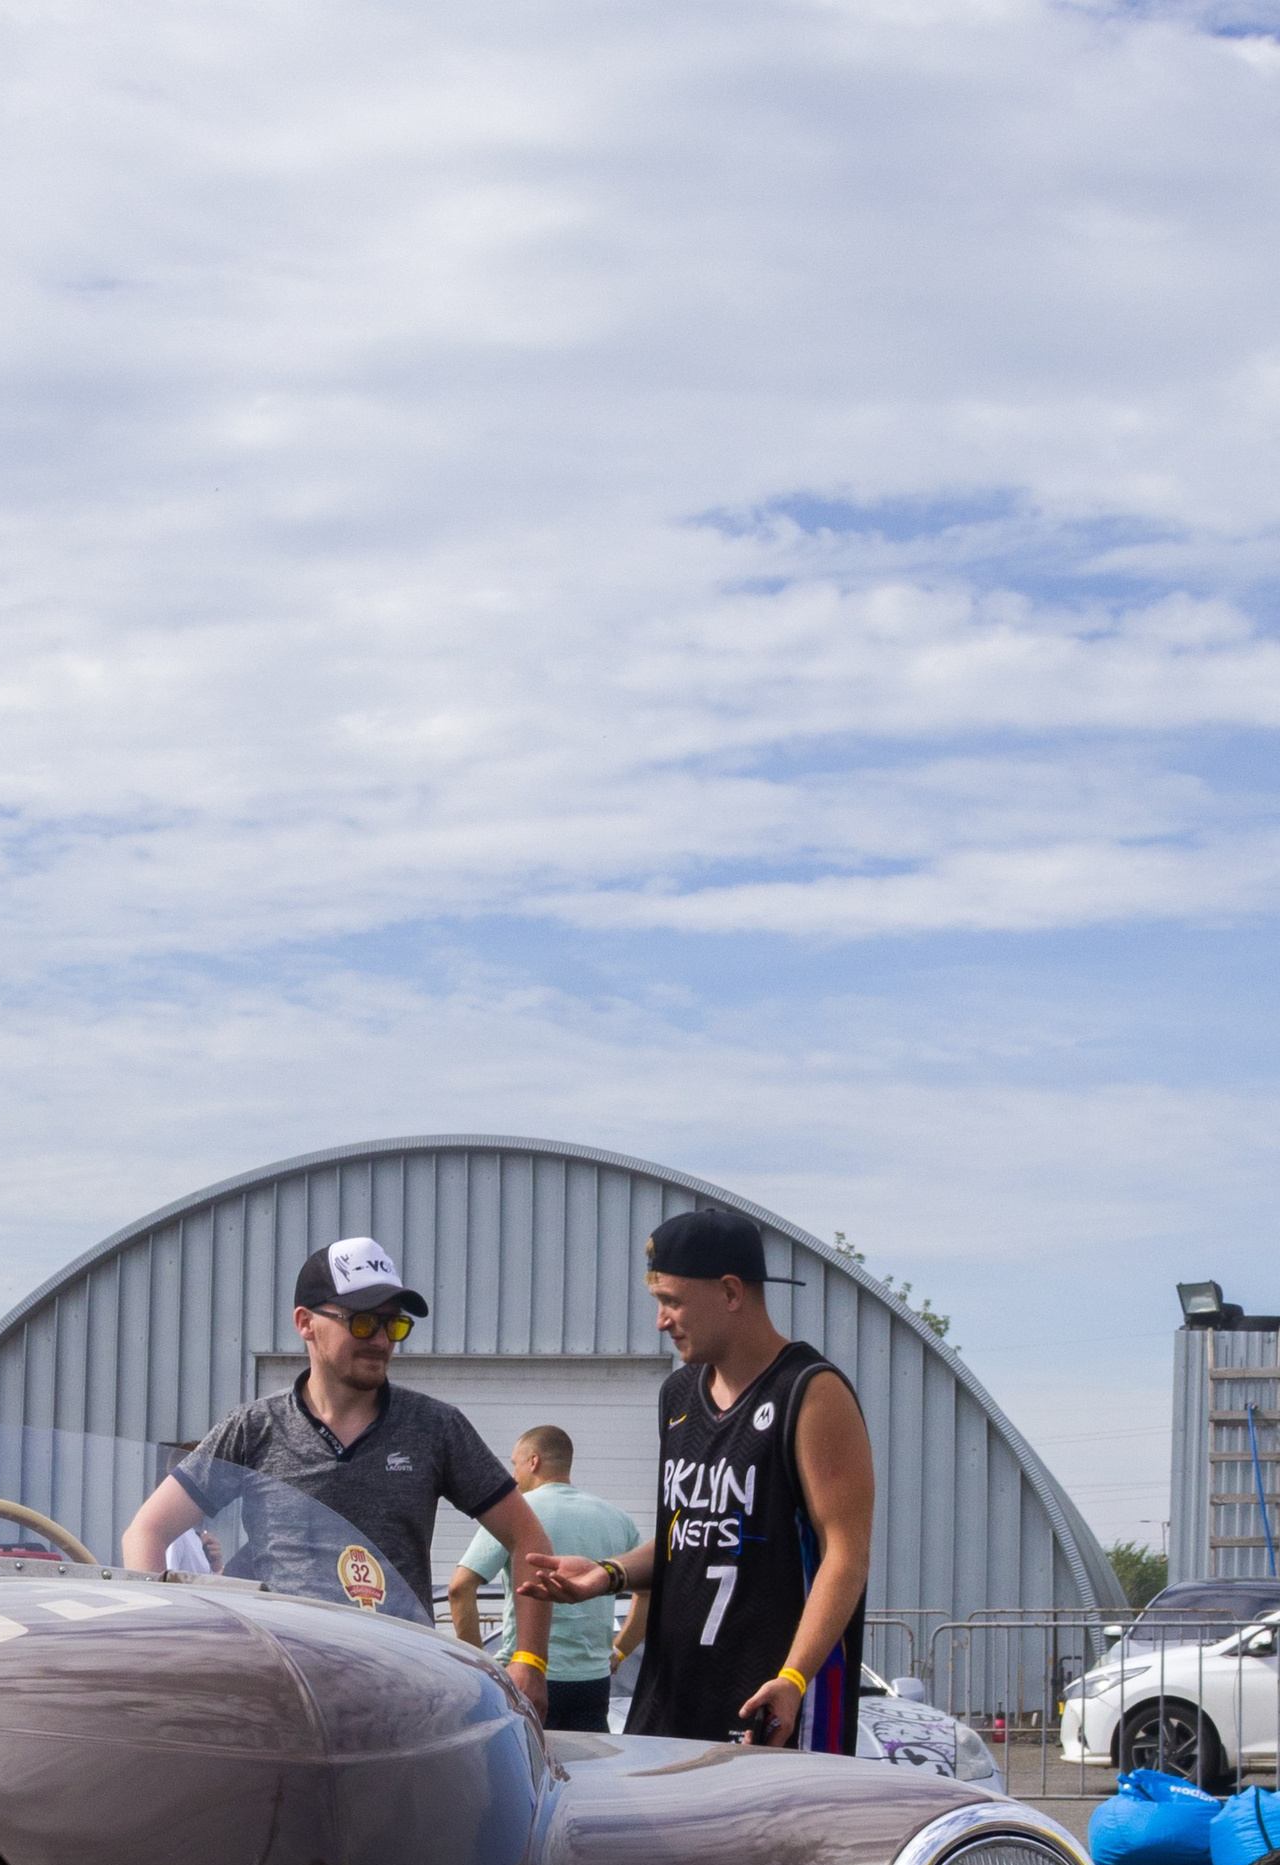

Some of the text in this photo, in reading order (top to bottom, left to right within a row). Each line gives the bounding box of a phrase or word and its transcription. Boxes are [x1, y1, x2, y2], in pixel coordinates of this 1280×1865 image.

[385, 1464, 413, 1472] LACOSTE
[664, 1457, 756, 1516] BKLYN
[671, 1518, 740, 1550] NETS
[351, 1563, 371, 1583] 32
[699, 1566, 738, 1646] 7
